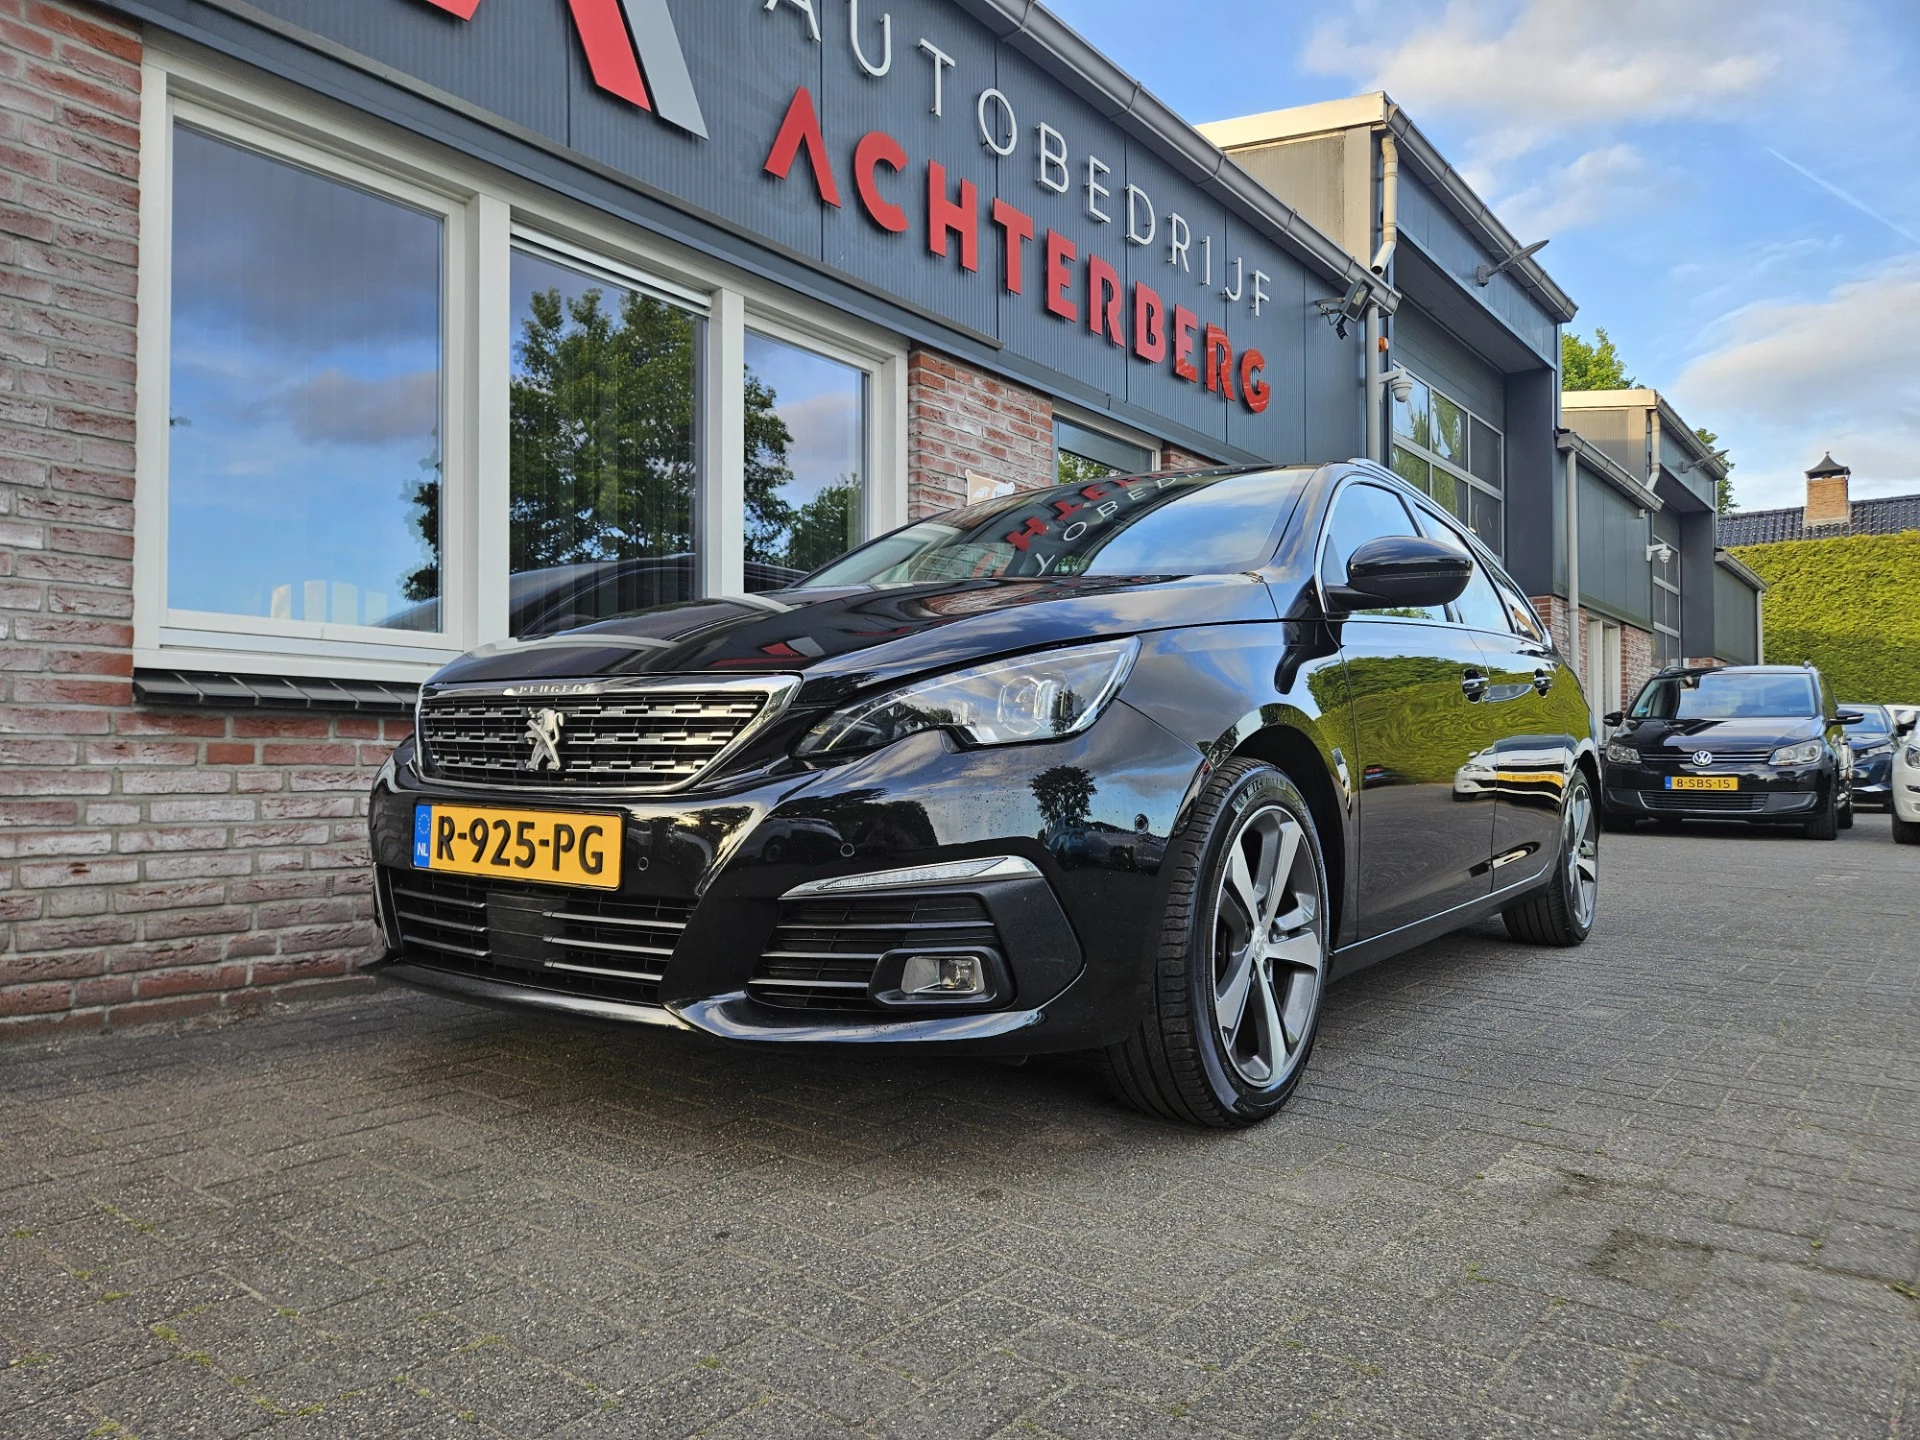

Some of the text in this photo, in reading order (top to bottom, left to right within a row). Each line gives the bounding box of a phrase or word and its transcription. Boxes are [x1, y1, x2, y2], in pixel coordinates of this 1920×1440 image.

[763, 86, 1270, 413] ACHTERBERG
[519, 682, 596, 694] PEUGEOT
[1676, 778, 1730, 789] 8-SBS-15
[417, 842, 428, 857] NL
[437, 815, 603, 875] R-925-PG
